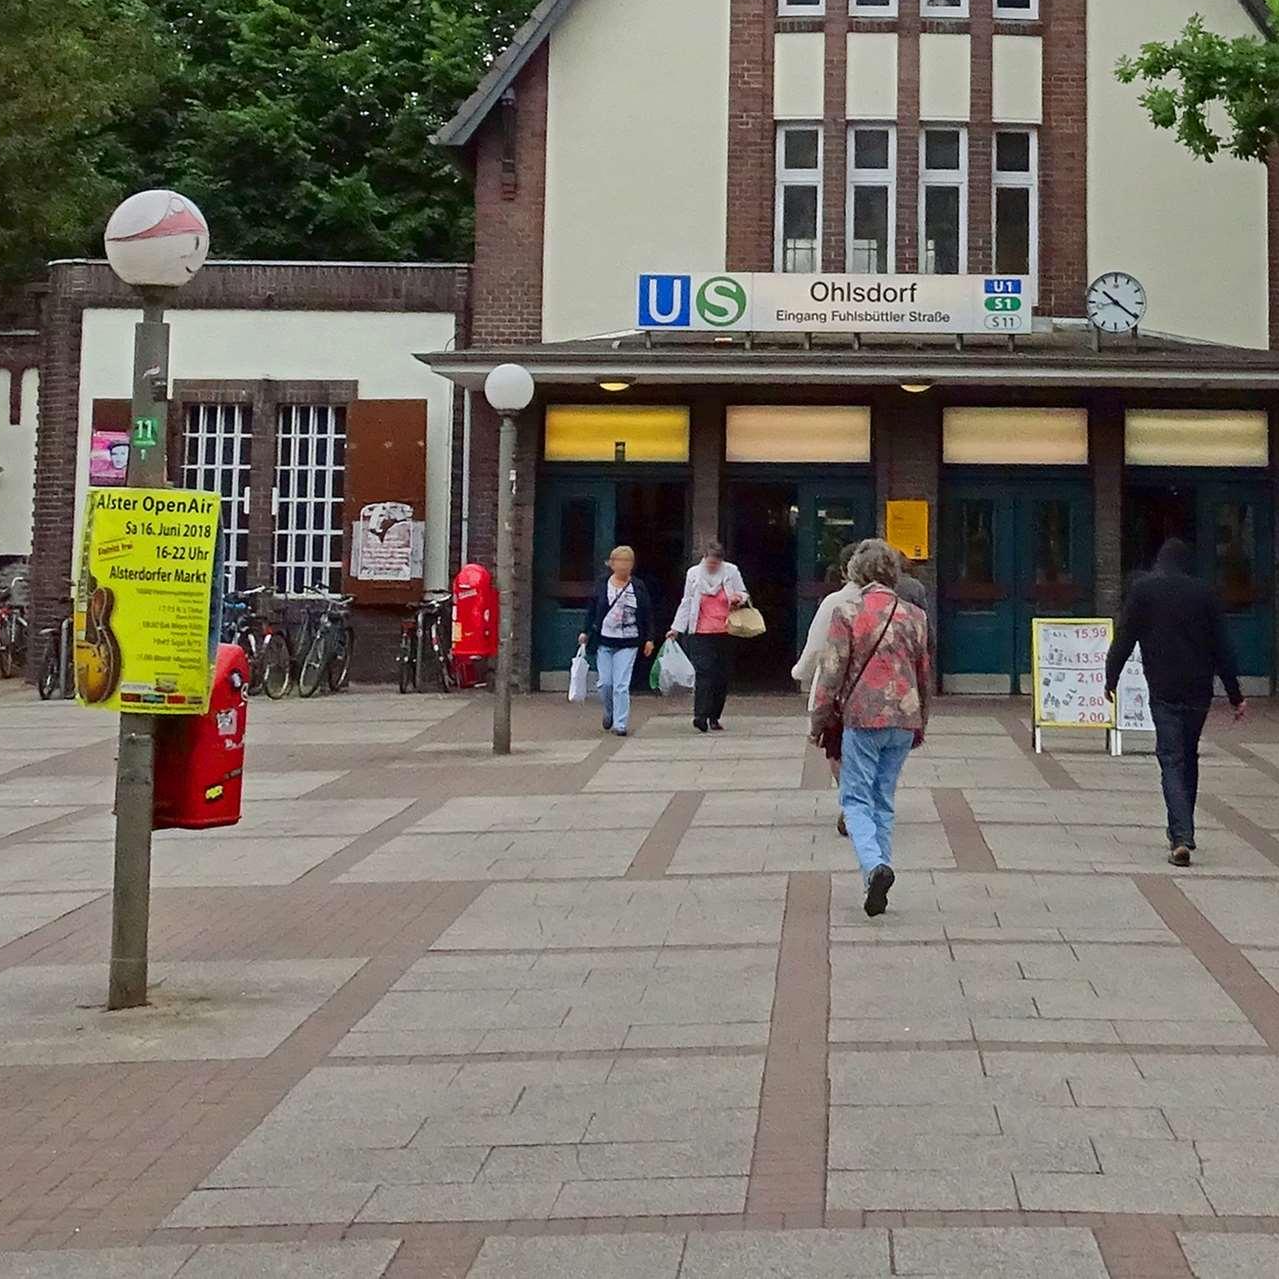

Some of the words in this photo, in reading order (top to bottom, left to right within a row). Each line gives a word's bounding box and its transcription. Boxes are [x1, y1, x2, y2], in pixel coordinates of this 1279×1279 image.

[810, 281, 918, 303] Ohlsdorf
[993, 279, 1013, 293] U1
[649, 278, 682, 324] U
[704, 279, 739, 323] S
[994, 299, 1012, 311] S1
[776, 310, 827, 323] Eingang
[831, 310, 905, 323] Fuhlsbüttler
[908, 311, 951, 324] Straße
[136, 420, 153, 439] 11
[96, 494, 138, 511] Alster
[142, 496, 213, 515] OpenAir
[125, 521, 138, 535] Sa
[141, 522, 156, 536] 16.
[158, 523, 181, 537] Juni
[183, 524, 211, 538] 2018
[156, 545, 186, 561] 16-22
[188, 546, 209, 561] Uhr
[109, 565, 172, 583] Alsterdorfer
[174, 568, 207, 585] Markt
